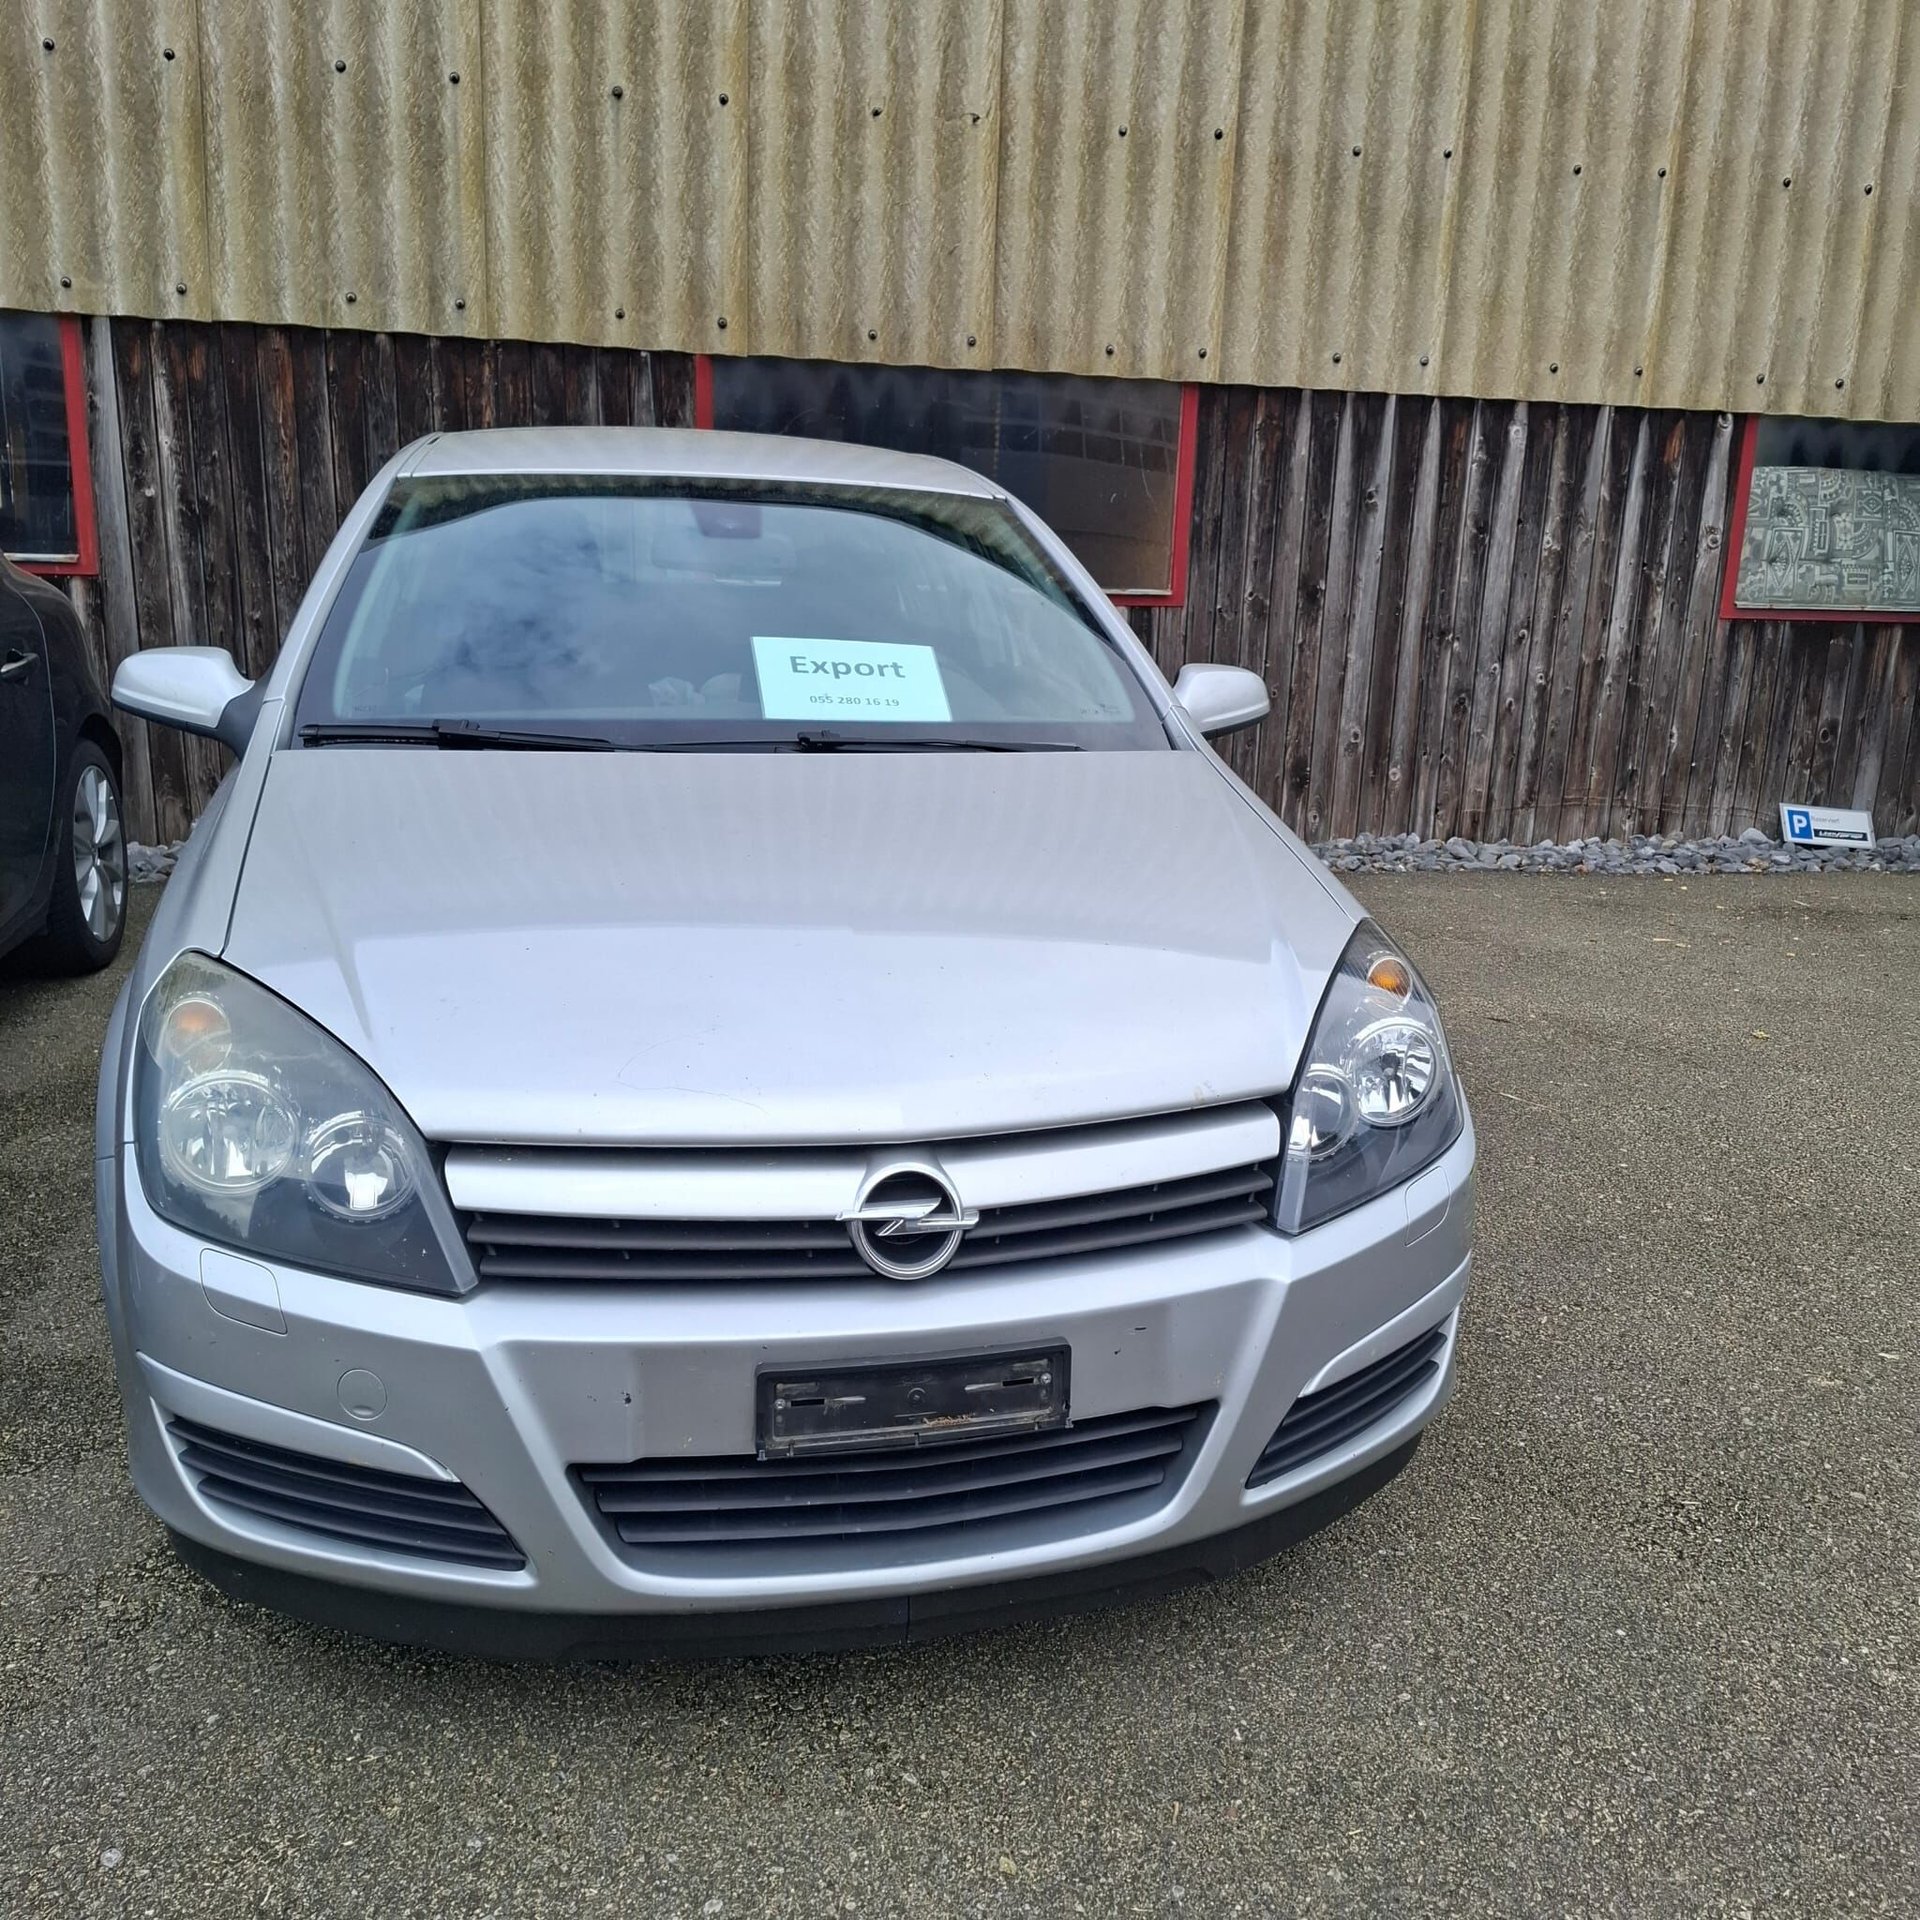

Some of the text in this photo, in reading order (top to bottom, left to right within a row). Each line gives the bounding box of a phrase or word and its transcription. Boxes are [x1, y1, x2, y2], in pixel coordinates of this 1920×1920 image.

[790, 655, 906, 680] Export
[809, 694, 900, 707] 055 280 16 19
[1792, 814, 1808, 834] P
